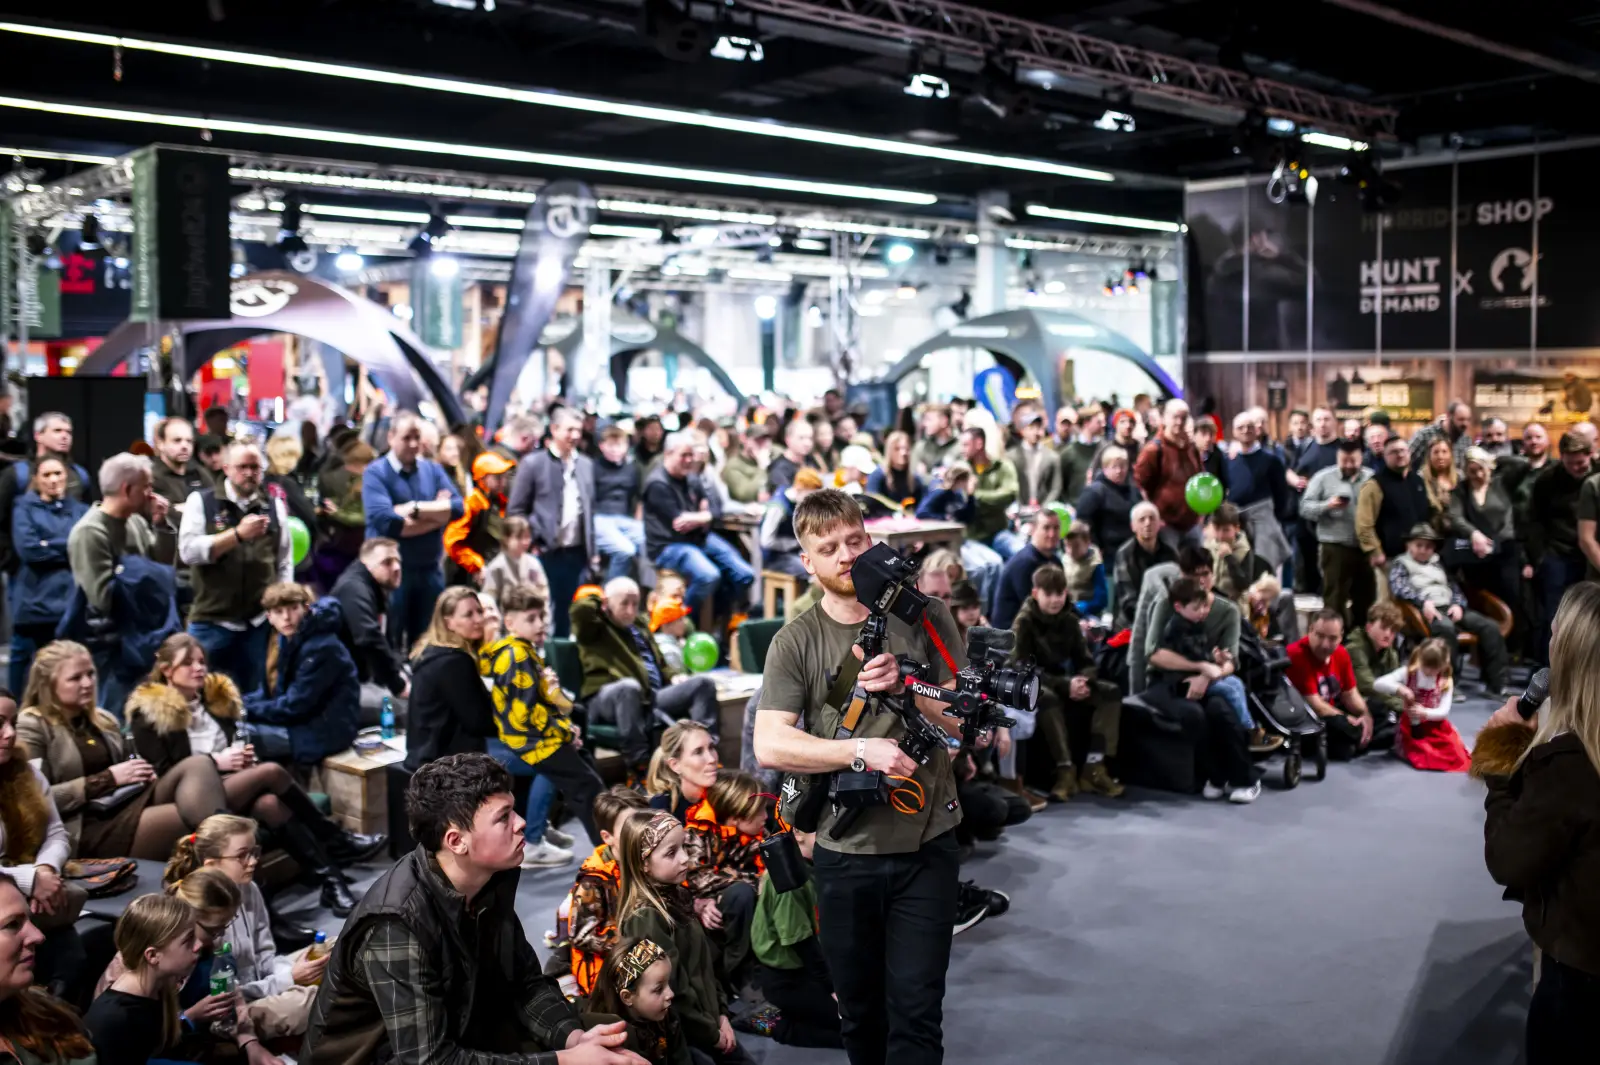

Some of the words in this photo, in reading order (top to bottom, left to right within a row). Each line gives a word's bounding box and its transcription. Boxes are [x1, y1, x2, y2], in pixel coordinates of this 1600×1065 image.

[1361, 204, 1473, 232] HRRIDO
[1476, 196, 1553, 225] SHOP
[1360, 256, 1441, 285] HUNT
[1360, 295, 1440, 313] DMAND
[912, 681, 941, 699] RONIN
